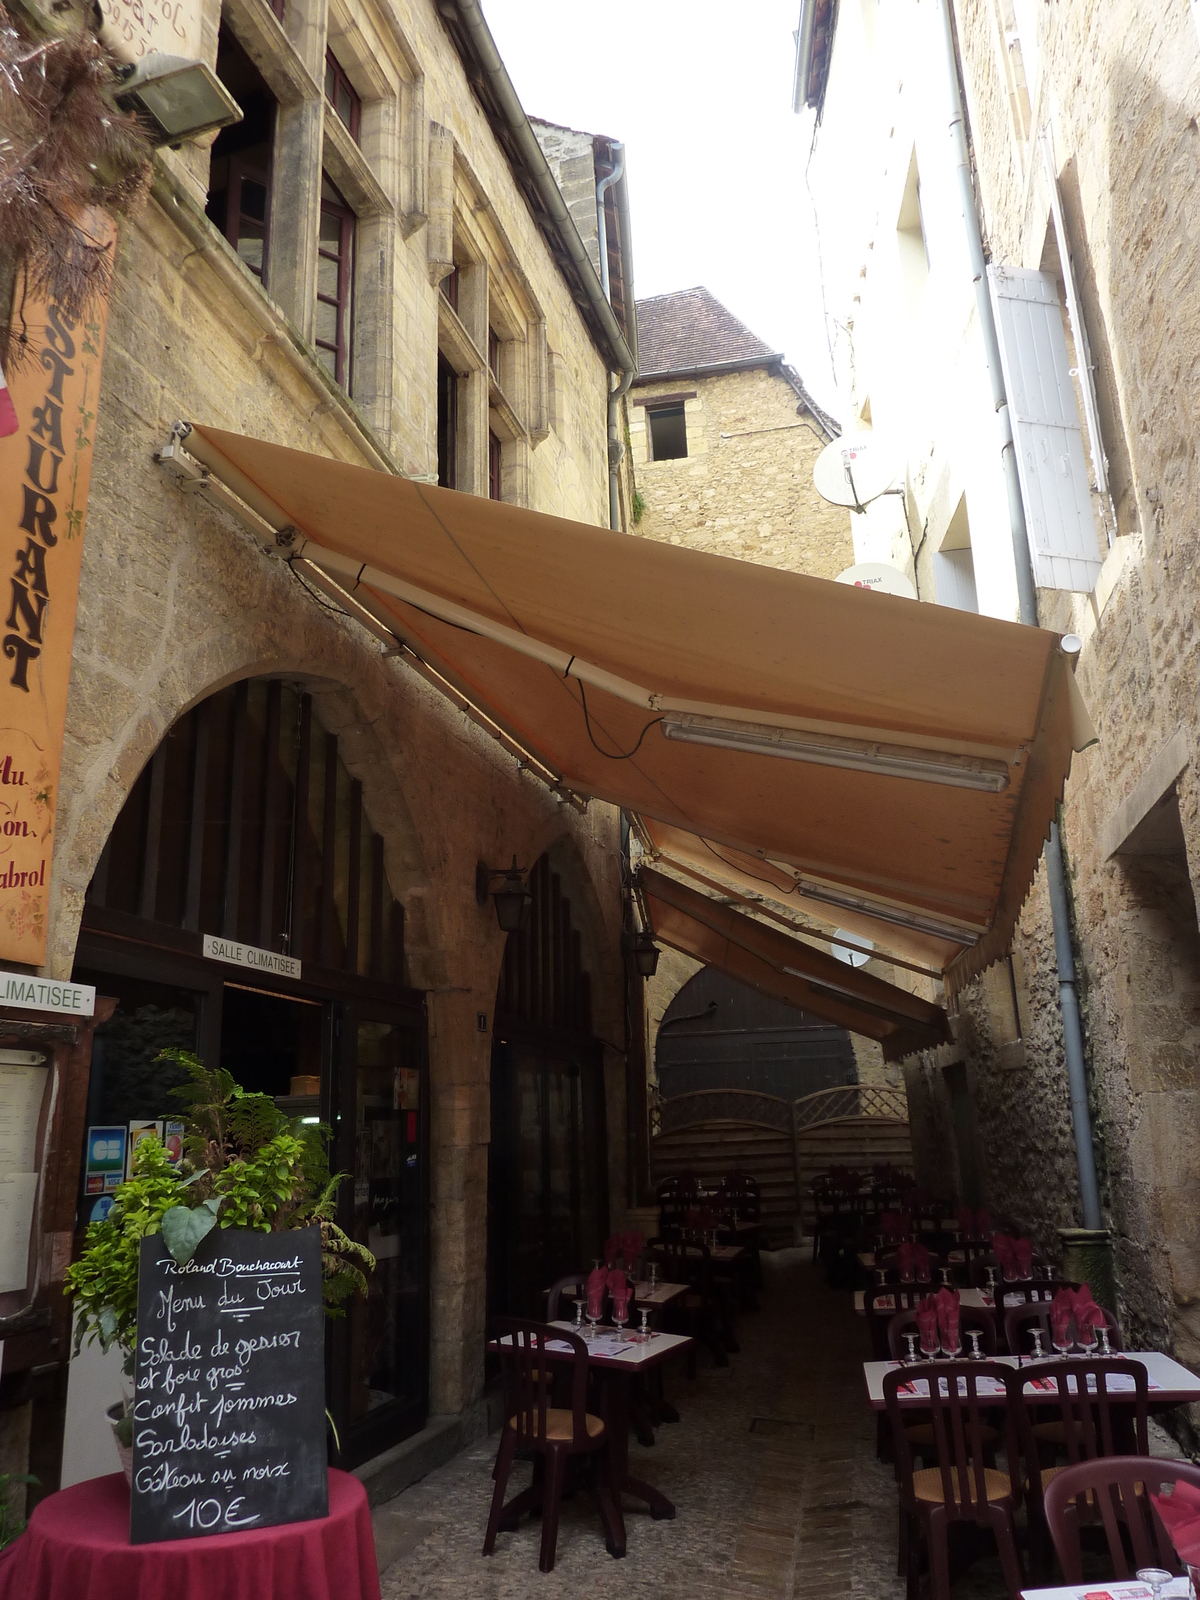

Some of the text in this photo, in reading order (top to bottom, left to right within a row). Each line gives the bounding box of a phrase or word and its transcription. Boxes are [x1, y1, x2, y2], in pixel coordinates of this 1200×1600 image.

[3, 300, 81, 693] STAURANT
[862, 577, 883, 585] TRIAX
[0, 820, 37, 838] on
[211, 940, 296, 975] SALLE CLIMATISEE
[156, 1258, 217, 1275] Roland
[157, 1279, 306, 1332] Menu du Jour
[140, 1330, 203, 1367] Salade
[211, 1329, 230, 1357] de
[137, 1367, 161, 1389] et
[161, 1363, 201, 1395] foie
[134, 1391, 298, 1428] Confit pommes
[173, 1496, 261, 1529] 10€
